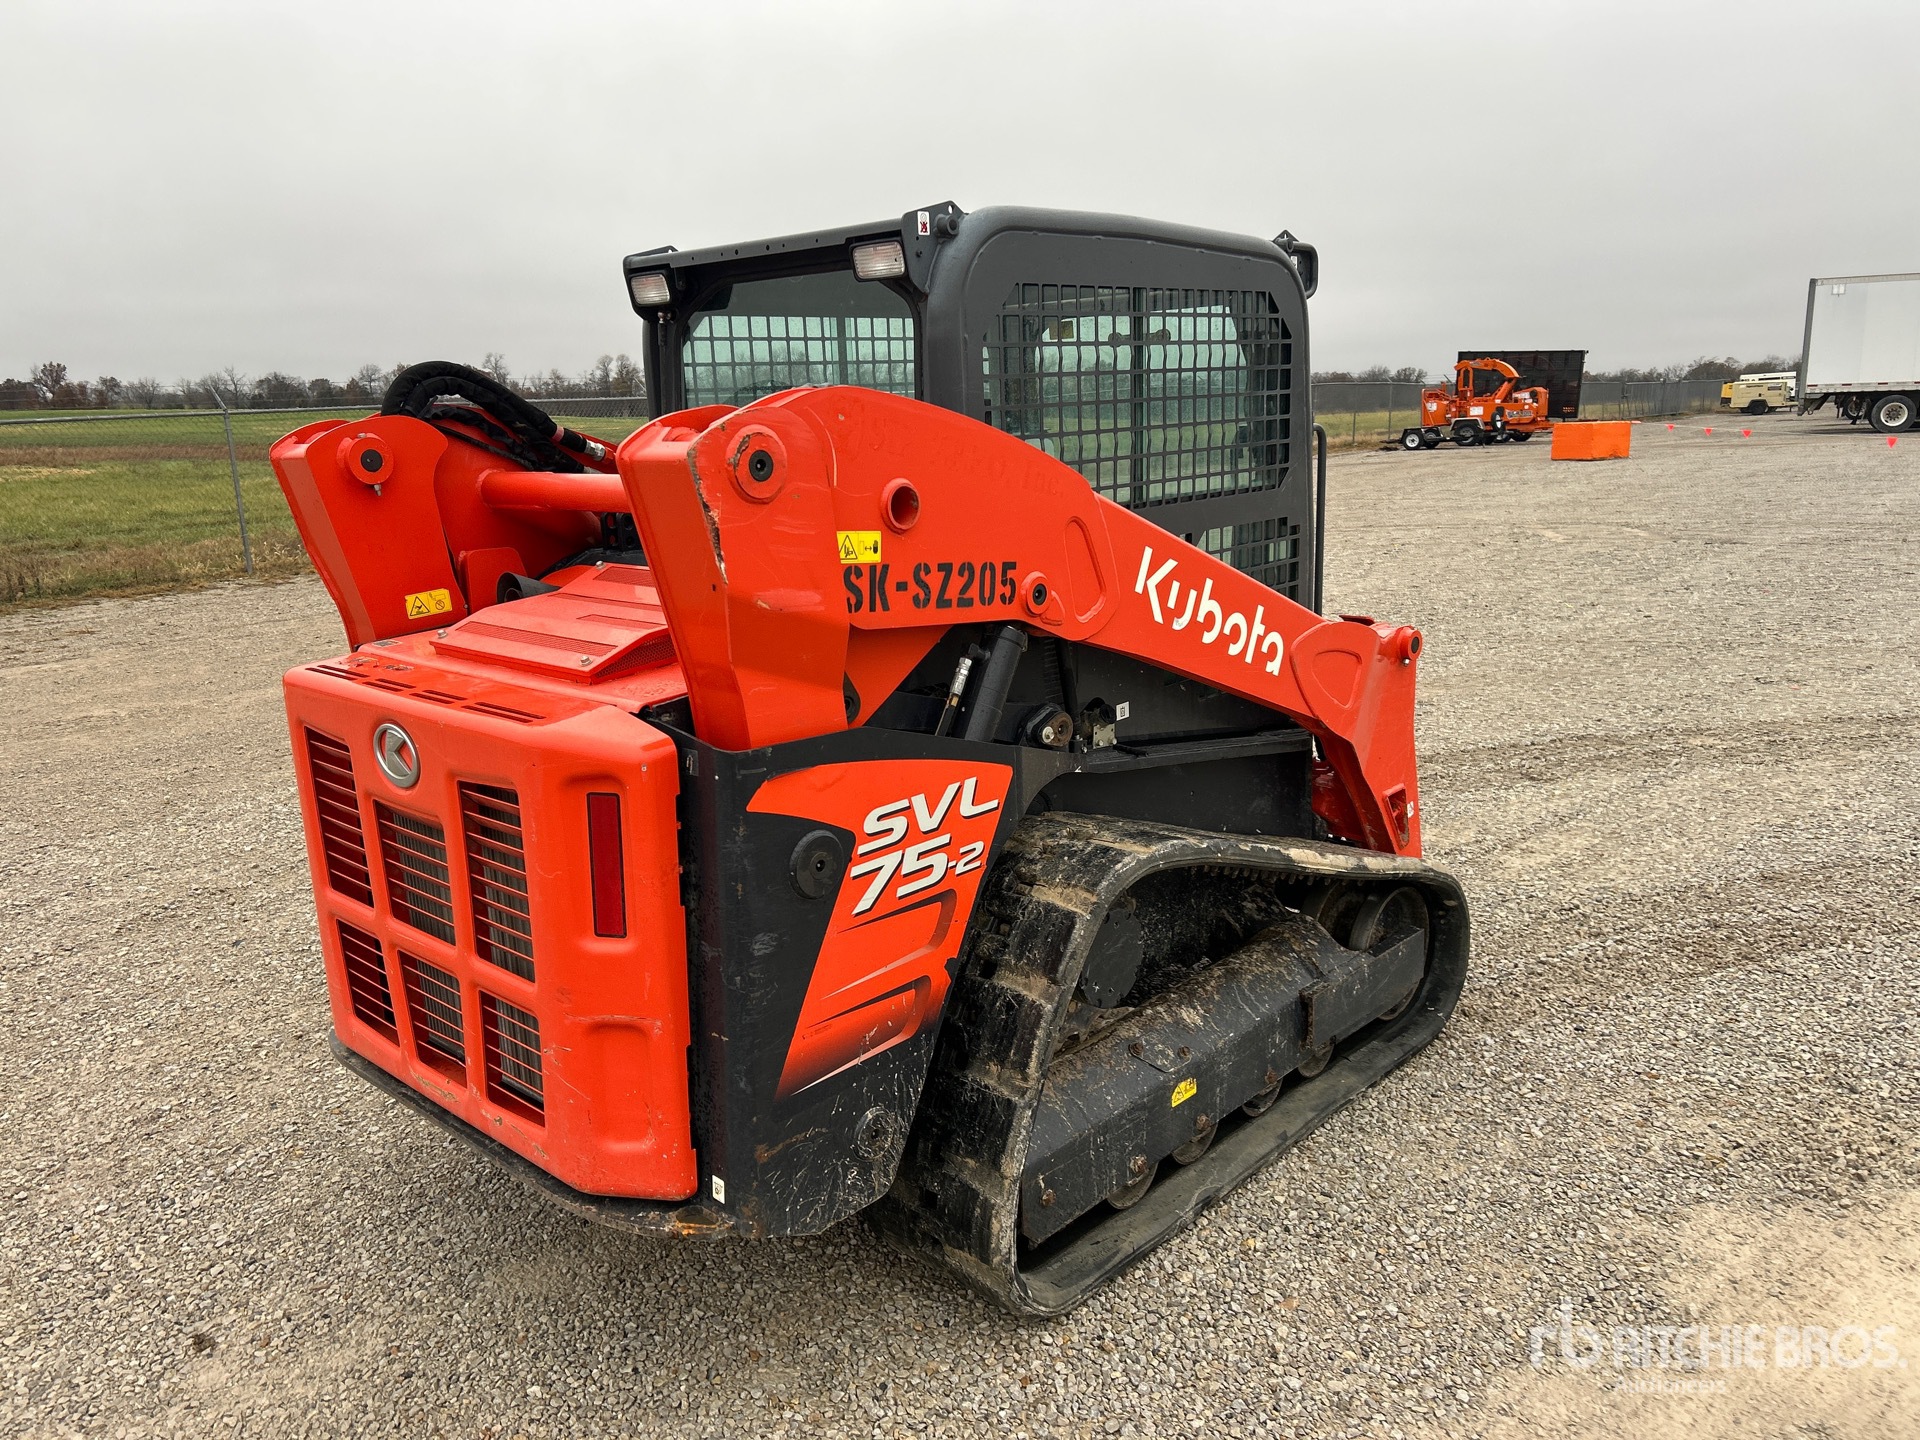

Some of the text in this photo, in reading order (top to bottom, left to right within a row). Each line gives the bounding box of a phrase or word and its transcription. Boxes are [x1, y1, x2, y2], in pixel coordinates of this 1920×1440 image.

[843, 561, 1017, 613] SK-SZ205
[1134, 545, 1285, 677] Kubota
[857, 776, 1000, 858] SVL
[850, 833, 985, 917] 75-2
